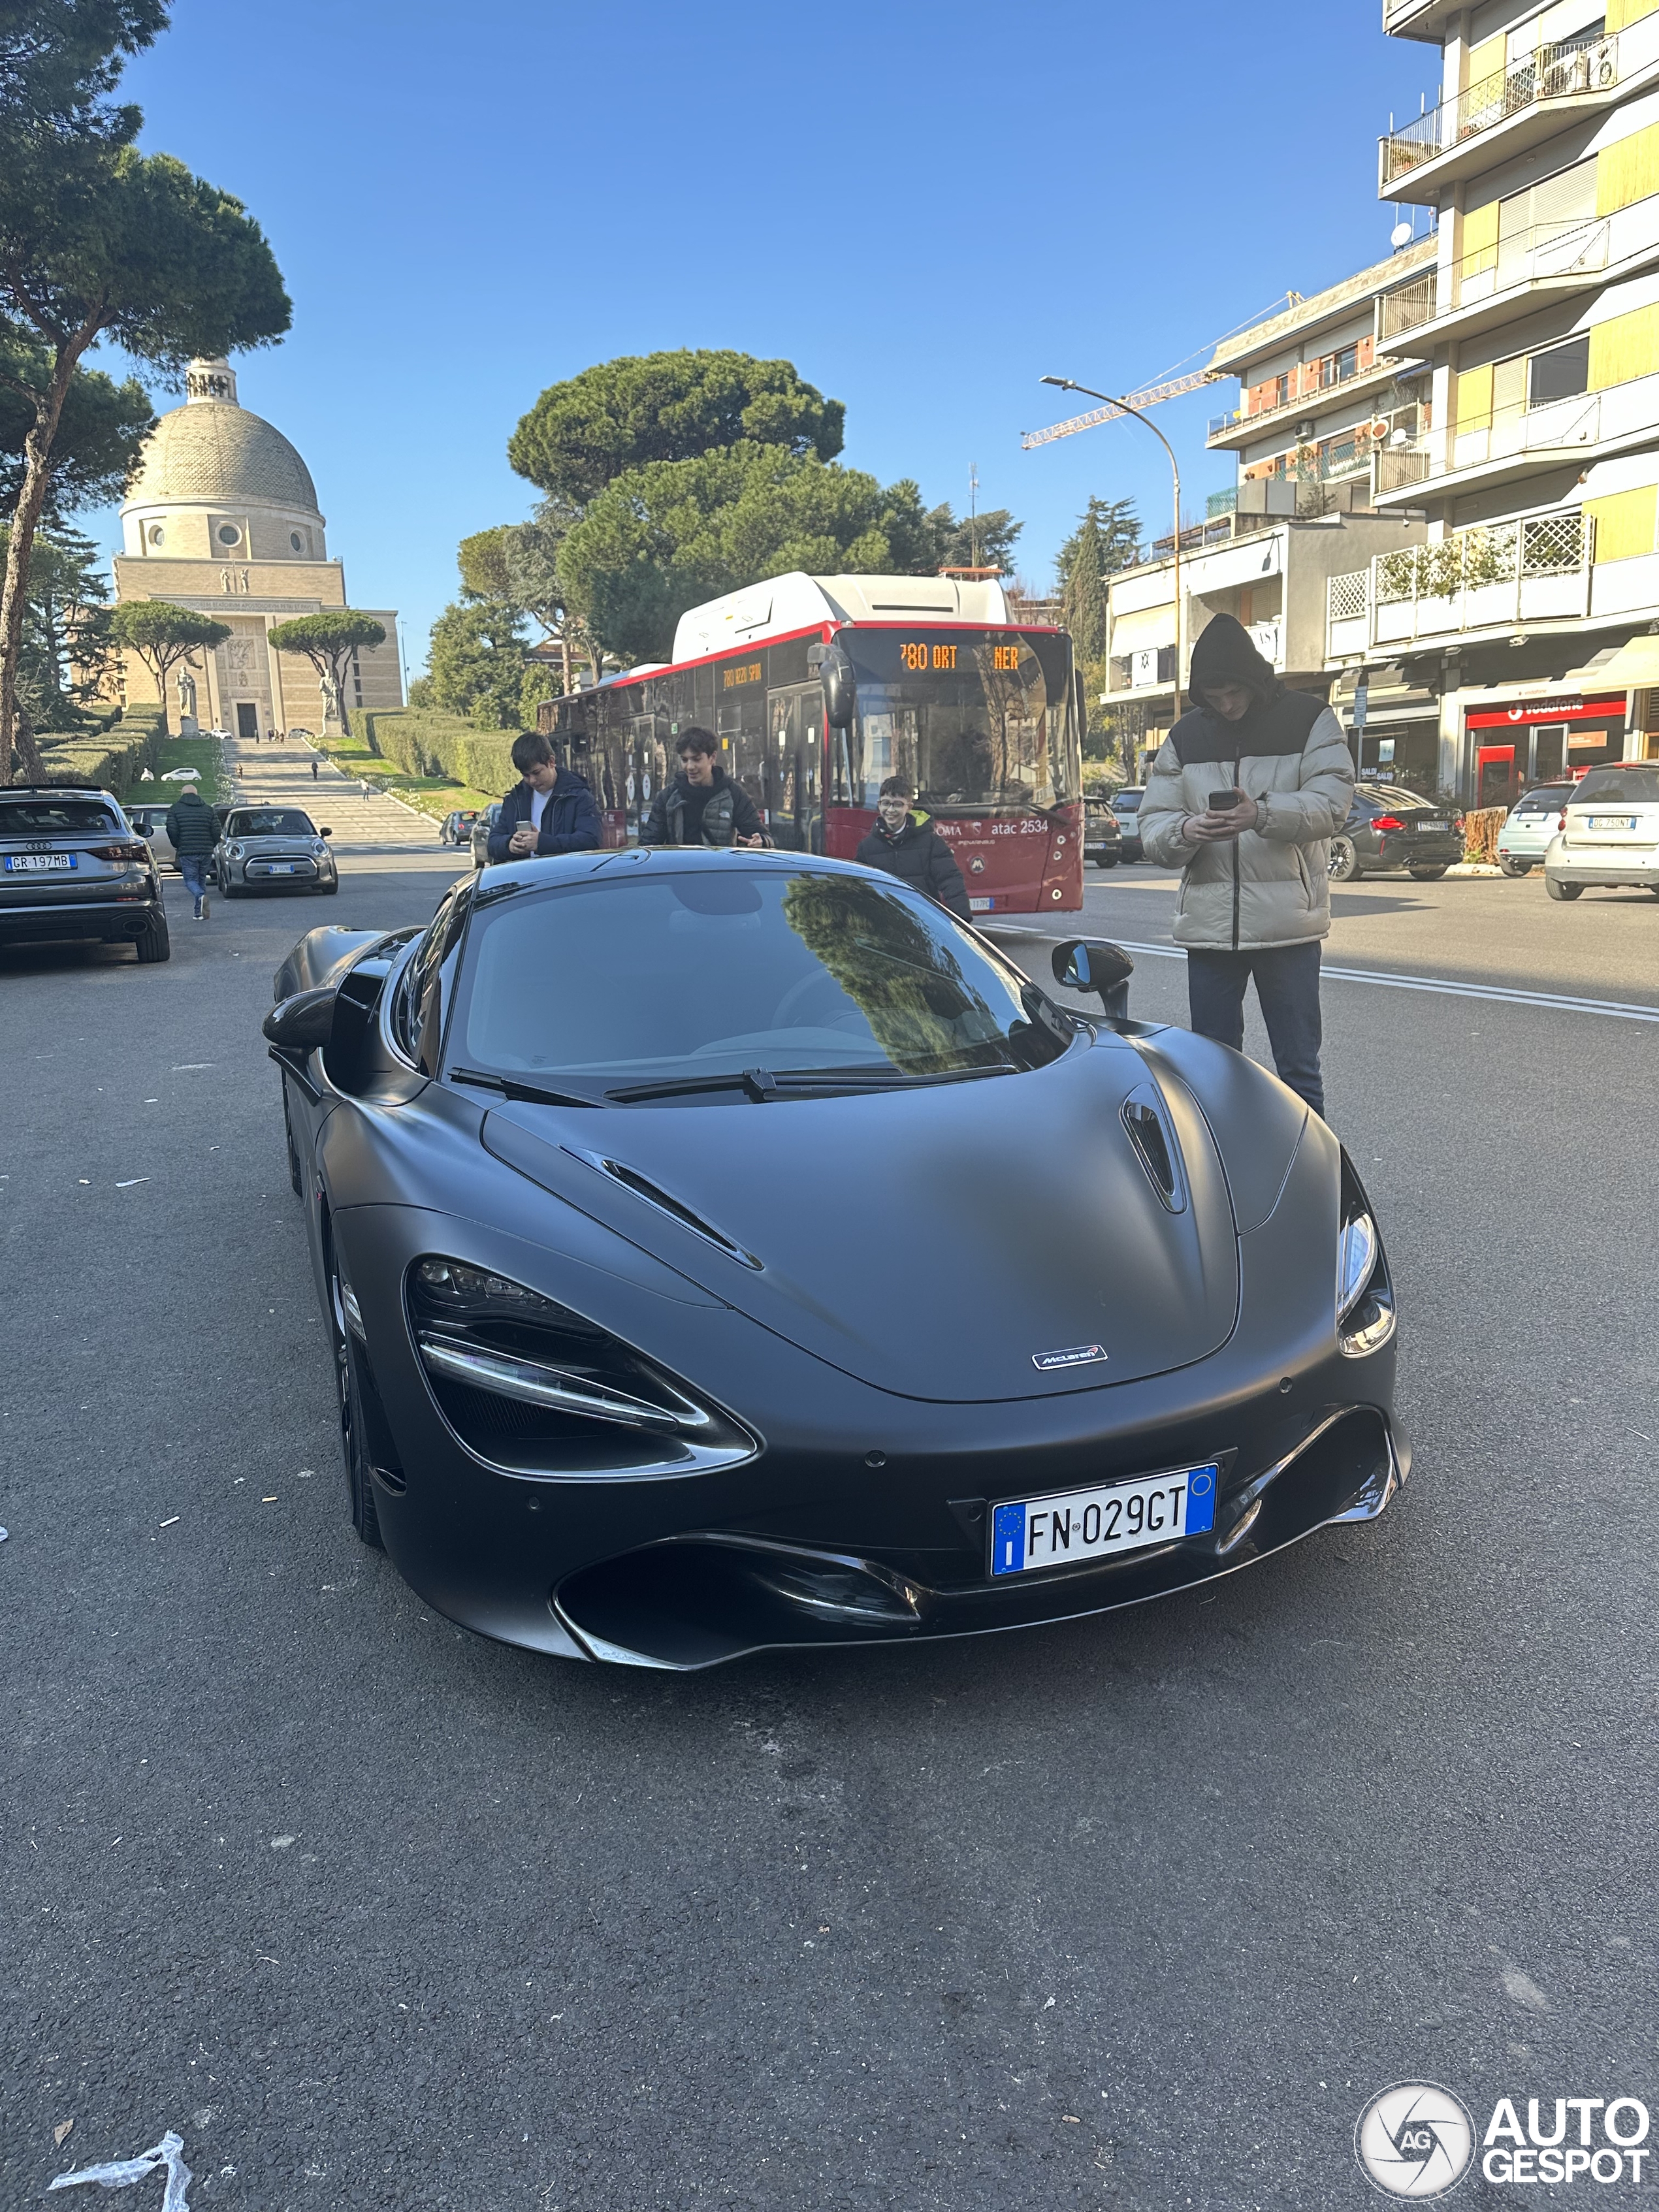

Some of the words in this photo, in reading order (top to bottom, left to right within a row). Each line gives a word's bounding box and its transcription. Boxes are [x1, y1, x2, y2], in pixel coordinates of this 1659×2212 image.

[900, 643, 928, 670] 780
[933, 645, 958, 669] ORT
[723, 669, 734, 688] 780
[1526, 698, 1584, 716] vodafone
[1361, 767, 1377, 776] SALDI
[934, 825, 962, 837] OMA
[991, 823, 1017, 835] atac
[1020, 820, 1049, 834] 2534
[13, 857, 27, 868] GR
[33, 855, 68, 867] 197MB
[1042, 1351, 1096, 1365] McLaren
[1028, 1508, 1071, 1556] FN
[1082, 1484, 1186, 1545] 029GT
